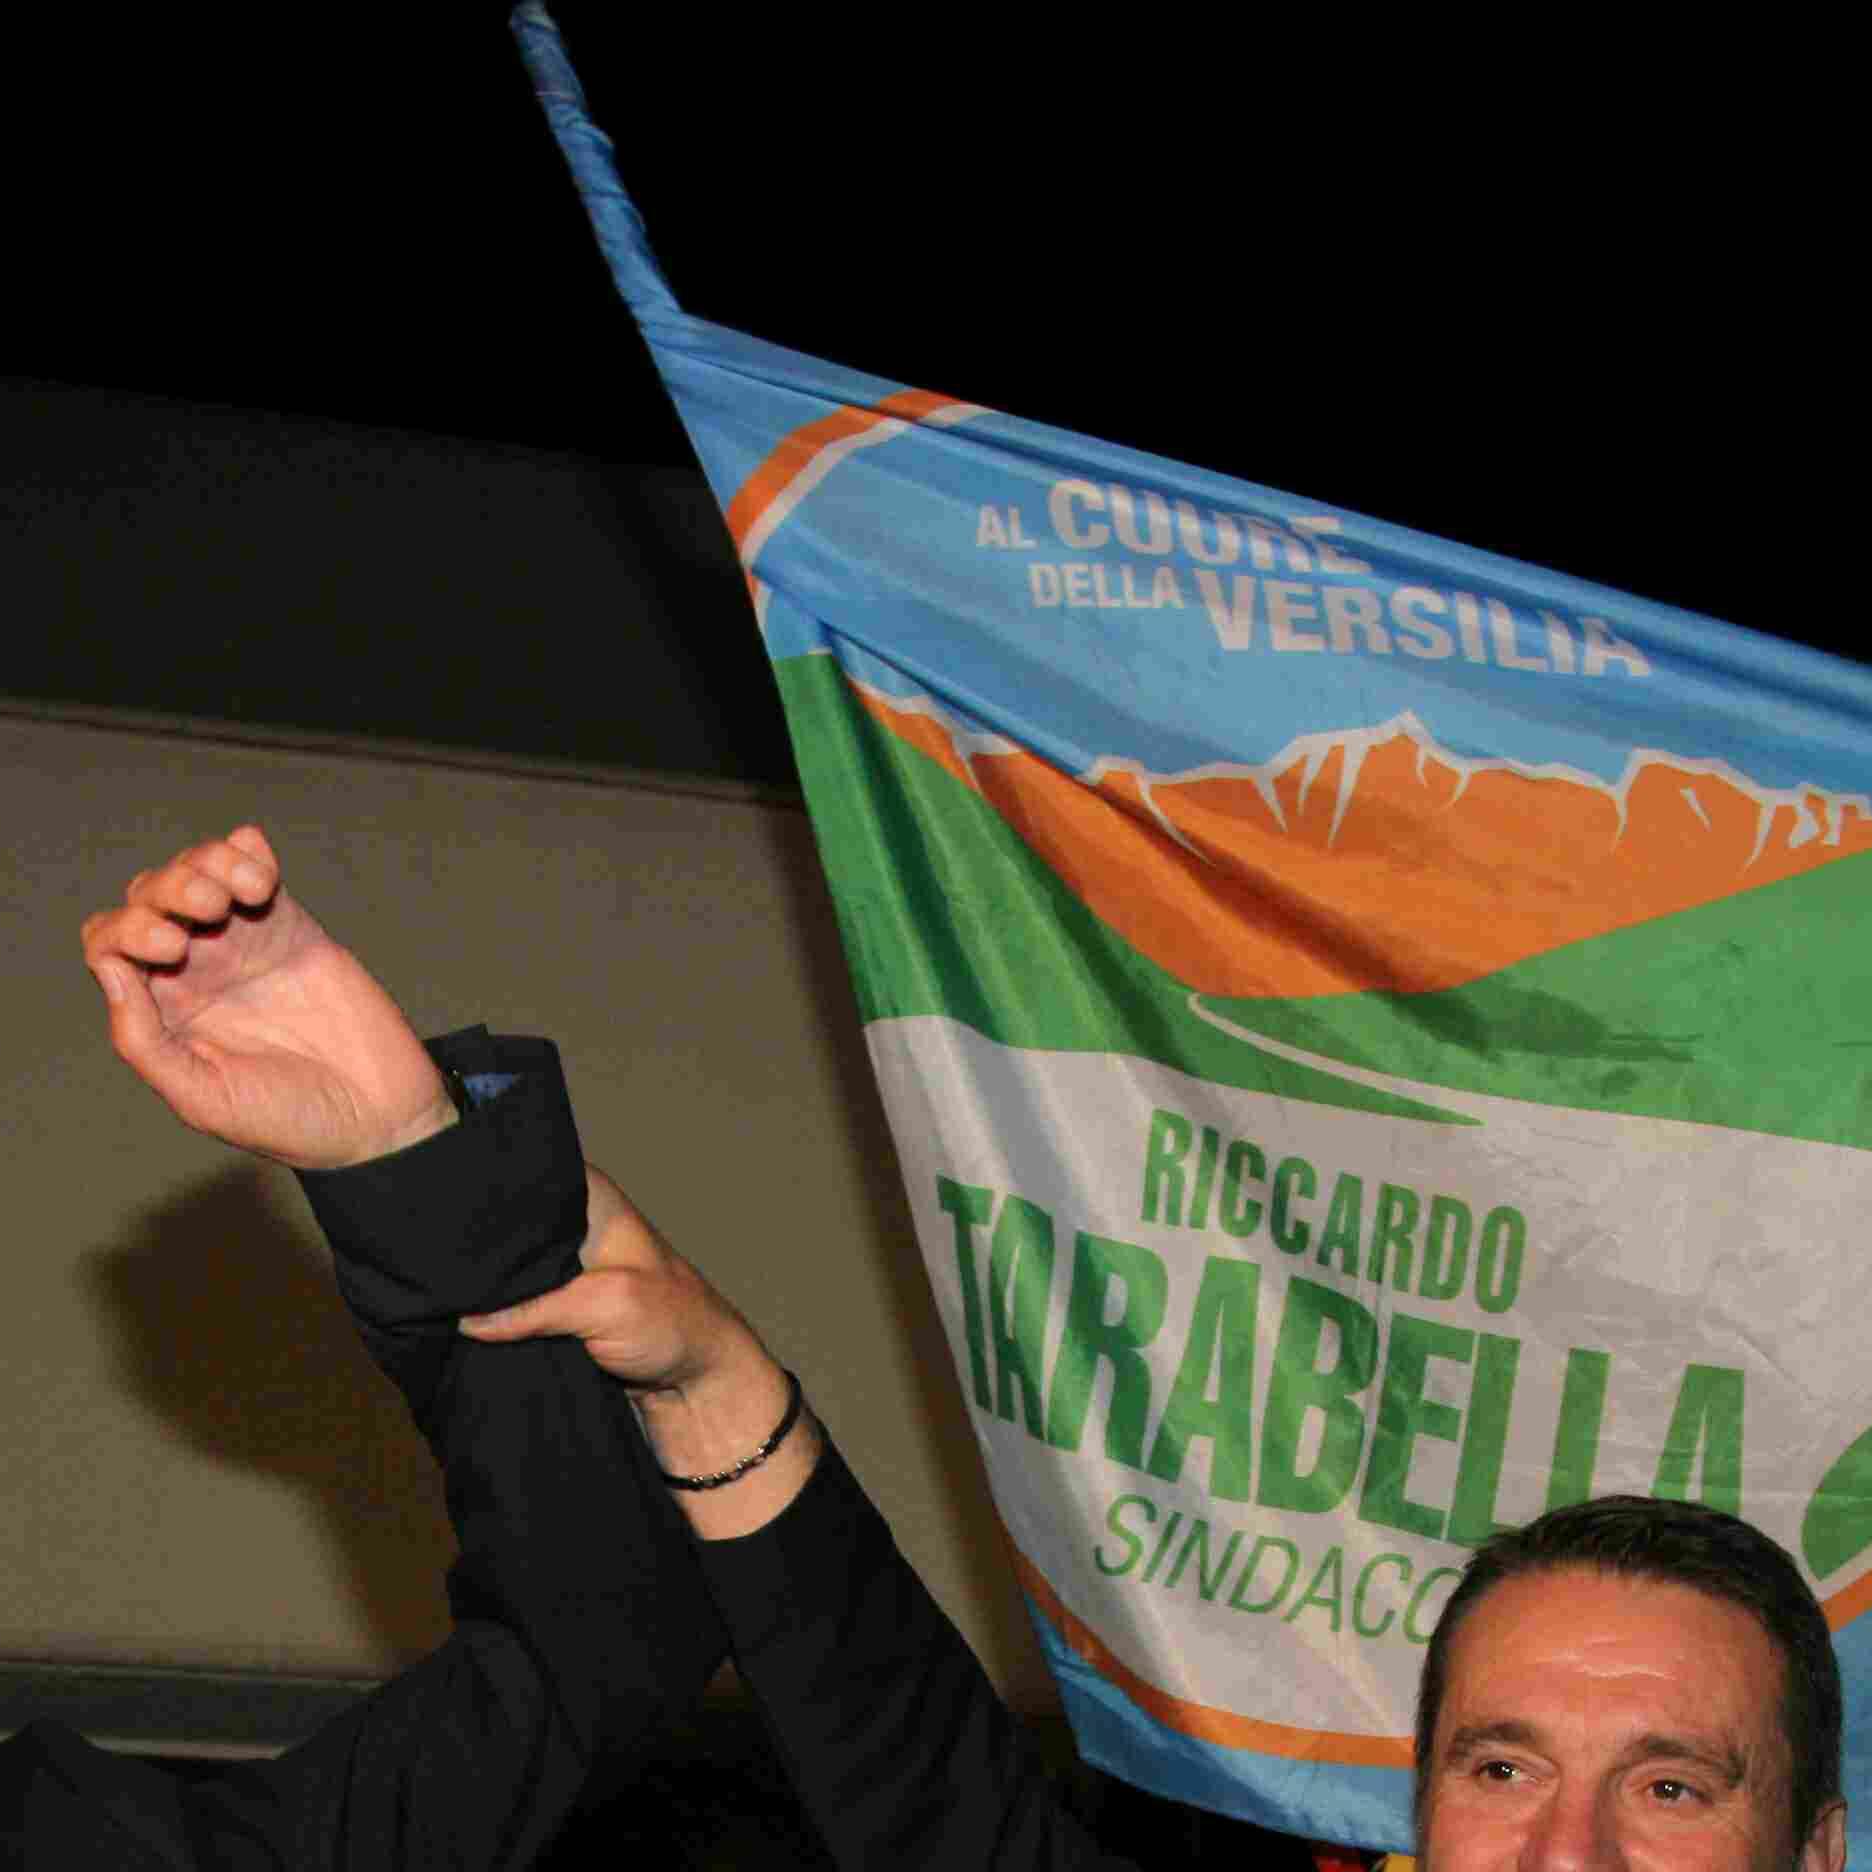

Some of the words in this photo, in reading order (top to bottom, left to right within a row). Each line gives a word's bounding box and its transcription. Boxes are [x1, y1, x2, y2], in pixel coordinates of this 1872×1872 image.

[976, 505, 1037, 551] AL
[1029, 561, 1184, 609] DELLA
[1194, 569, 1652, 678] VERSILIA
[1141, 1109, 1526, 1314] RICCARDO
[936, 1176, 1746, 1547] TARABELLA
